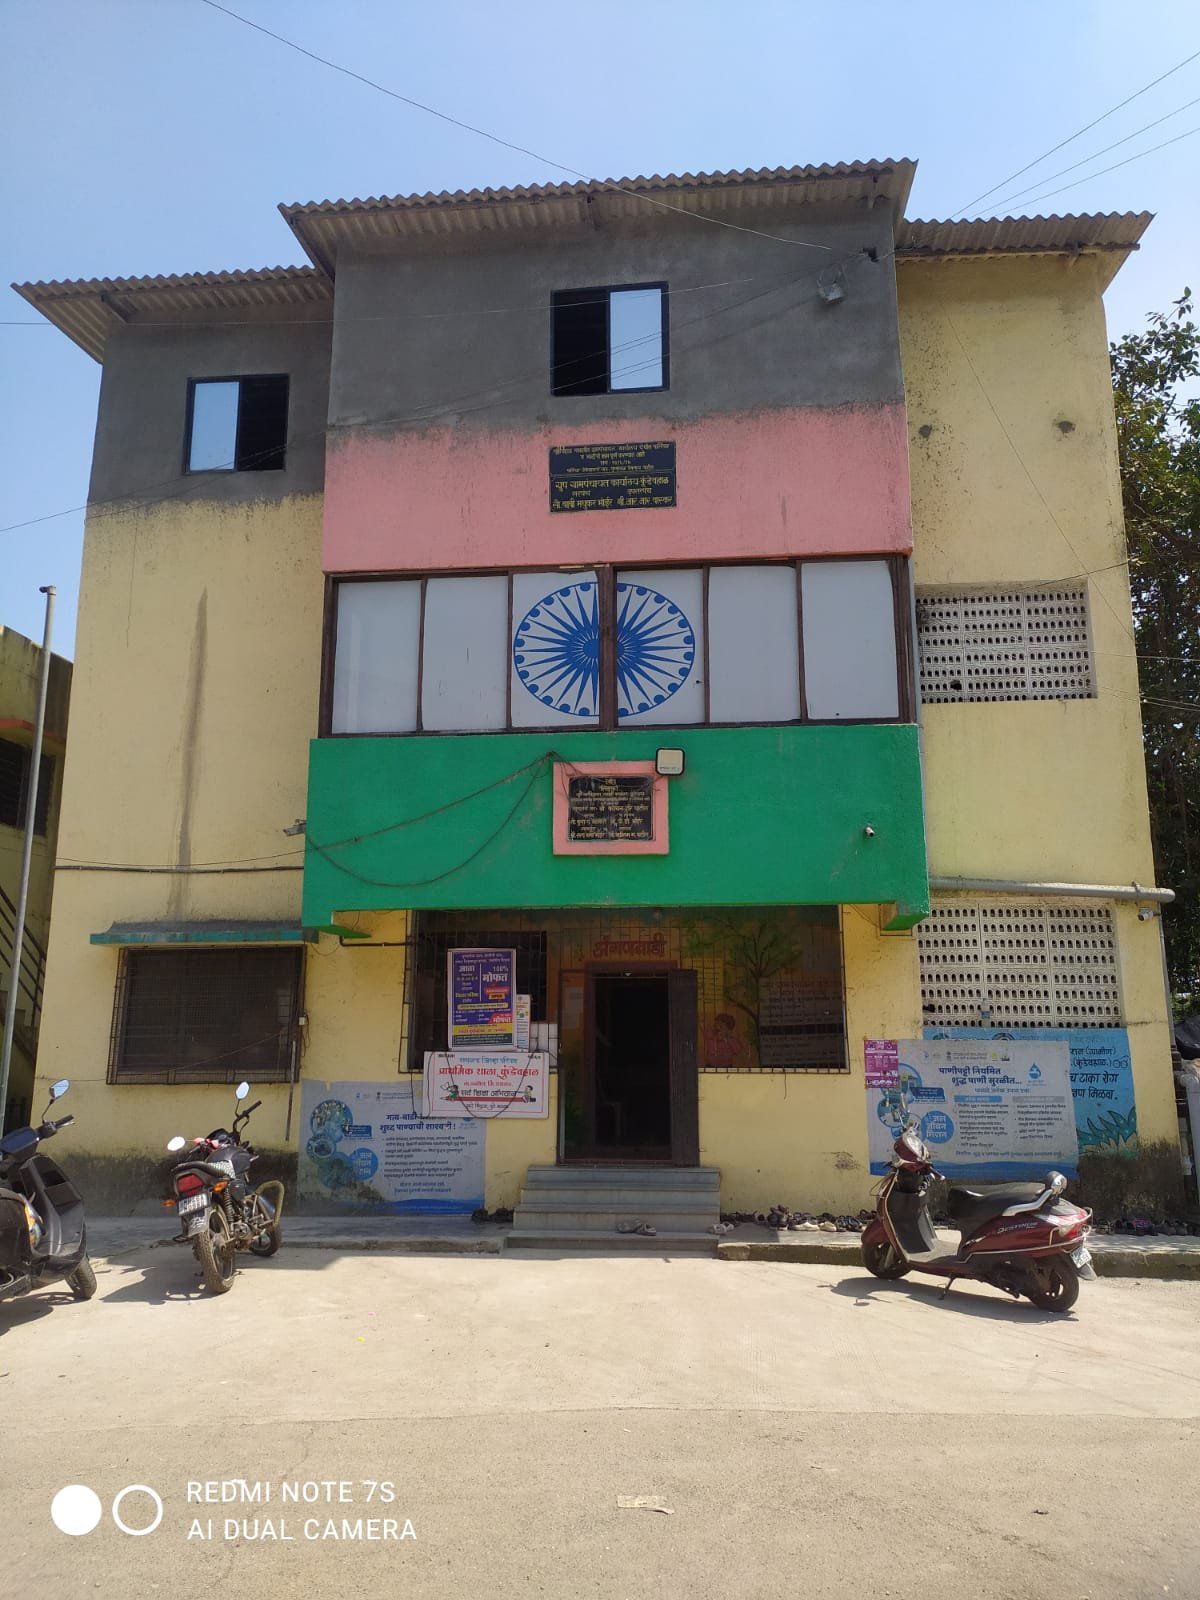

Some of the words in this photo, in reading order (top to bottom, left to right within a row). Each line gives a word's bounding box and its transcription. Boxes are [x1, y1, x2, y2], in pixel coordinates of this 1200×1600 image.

[482, 971, 508, 982] मोफत
[439, 1064, 474, 1076] प्राथमिक
[938, 1065, 970, 1077] पाणीपट्टी
[972, 1065, 1001, 1075] नियमित
[968, 1075, 987, 1085] पाणी
[1102, 1070, 1120, 1084] रोग
